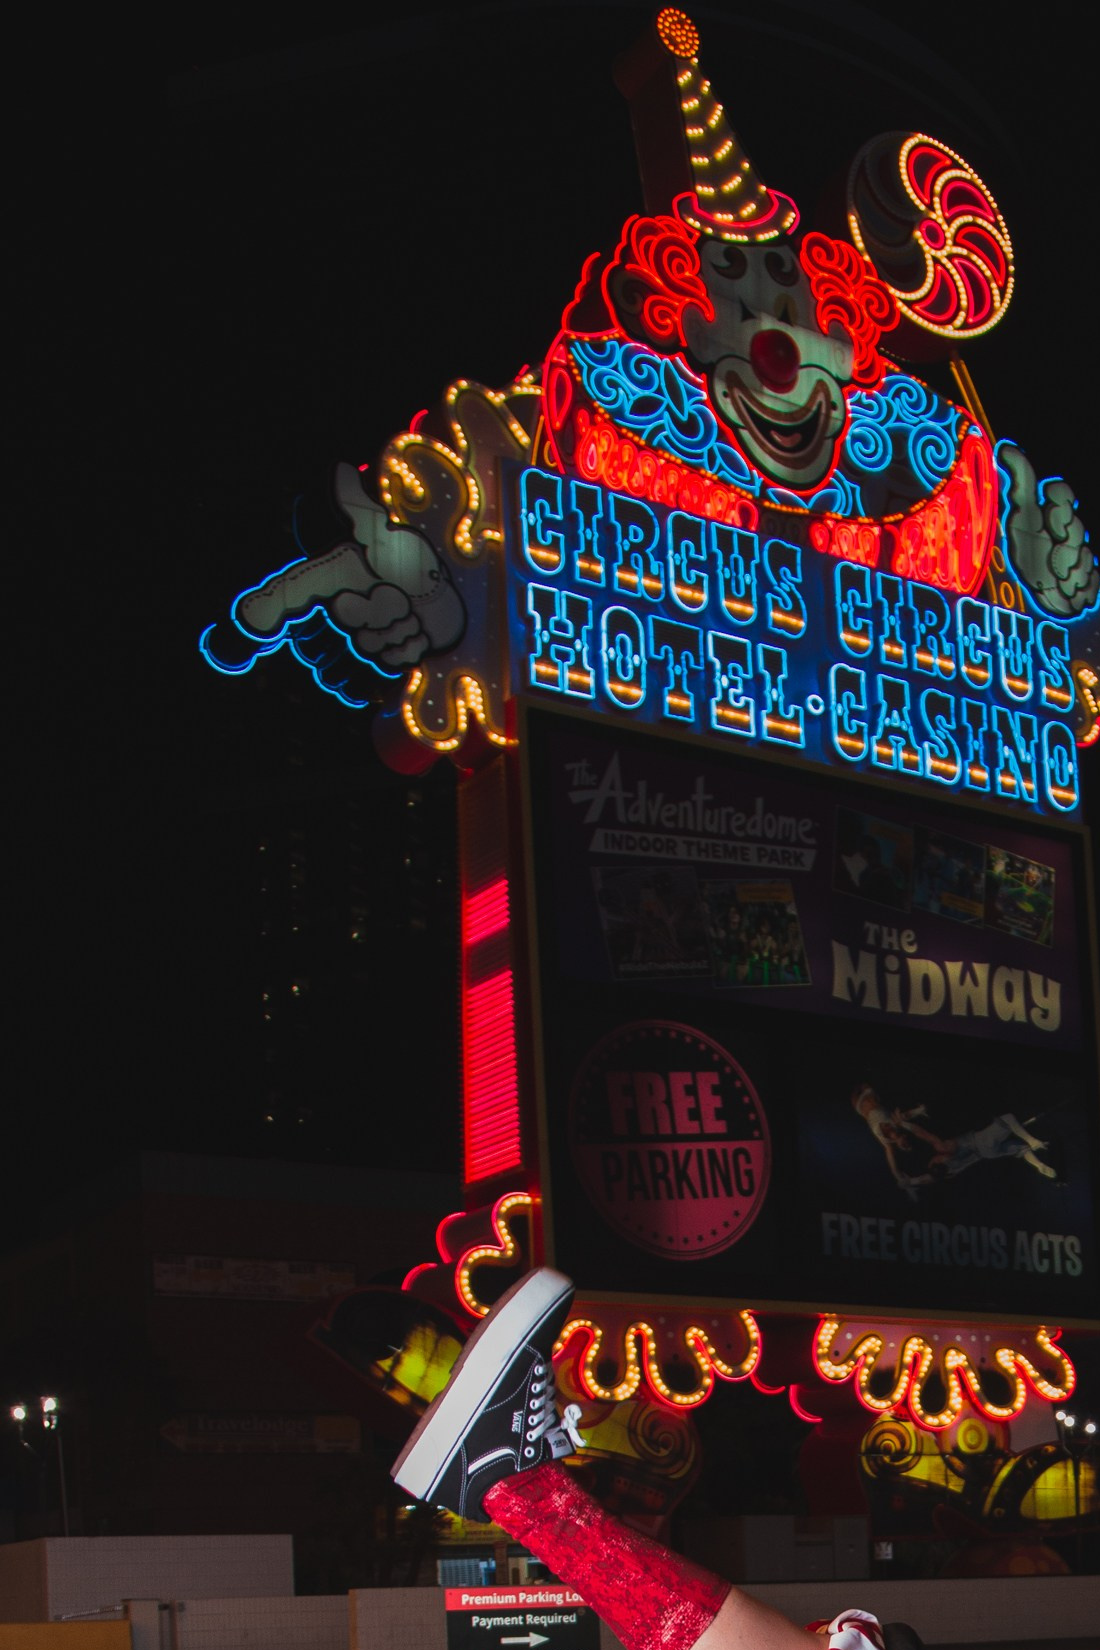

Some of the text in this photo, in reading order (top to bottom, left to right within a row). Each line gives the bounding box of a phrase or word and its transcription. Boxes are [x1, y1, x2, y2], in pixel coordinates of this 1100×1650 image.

[520, 468, 1075, 713] CIRCUS CIRCUS
[564, 758, 598, 786] The
[568, 750, 817, 844] Adventuredome
[603, 832, 806, 867] INDOOR THEME PARK
[605, 1071, 728, 1134] FREE
[602, 1147, 755, 1202] PARKING
[820, 1212, 1084, 1277] FREE CIRCUS ACTS
[461, 1592, 517, 1605] Premium
[519, 1591, 564, 1605] Parking
[472, 1613, 577, 1629] Payment Required
